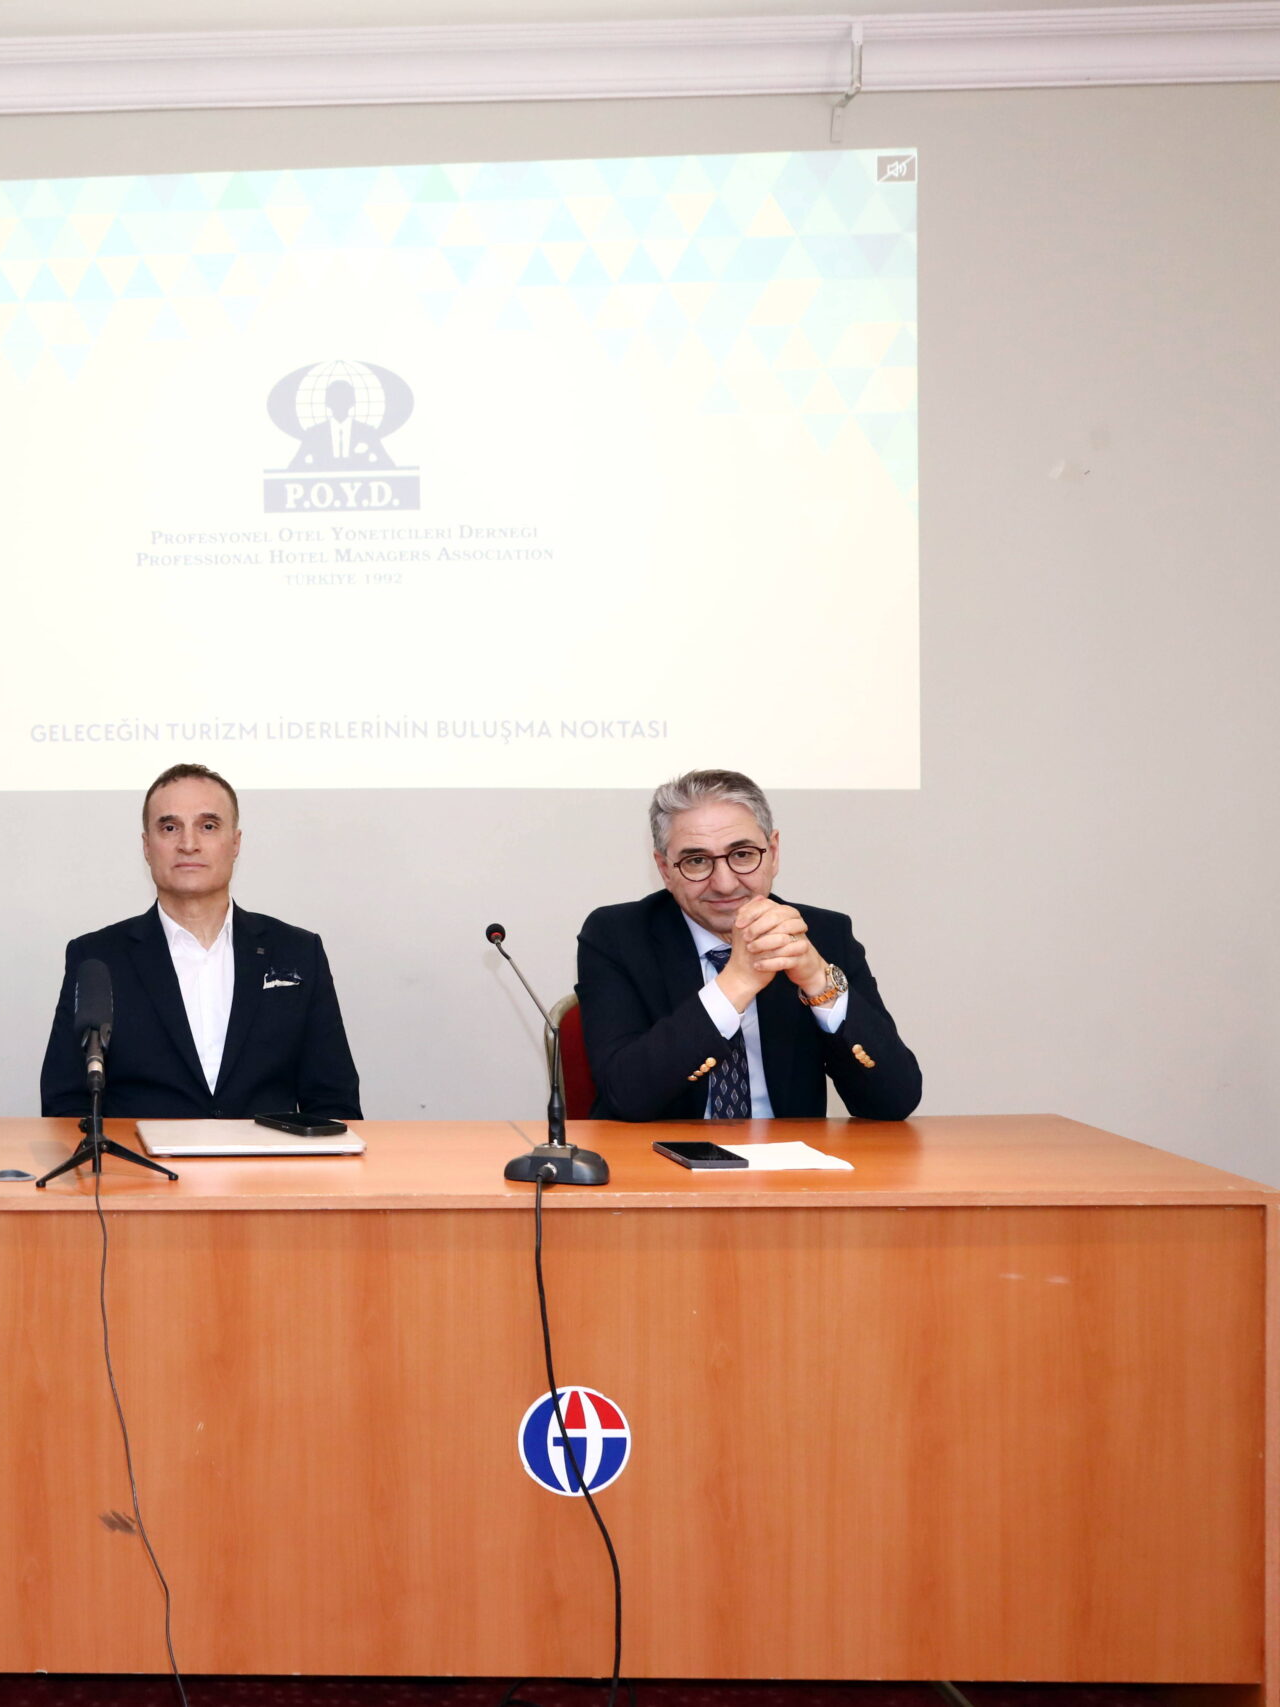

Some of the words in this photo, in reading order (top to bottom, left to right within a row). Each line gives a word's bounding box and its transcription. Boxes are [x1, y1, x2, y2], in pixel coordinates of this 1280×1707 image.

[283, 481, 400, 509] P.O.Y.D.
[364, 571, 403, 585] 1992
[29, 717, 160, 744] GELECEĞİN
[167, 715, 259, 742] TURİZM
[266, 713, 429, 741] LİDERLERİNİN
[436, 719, 553, 746] BULUŞMA
[560, 718, 669, 740] NOKTASI
